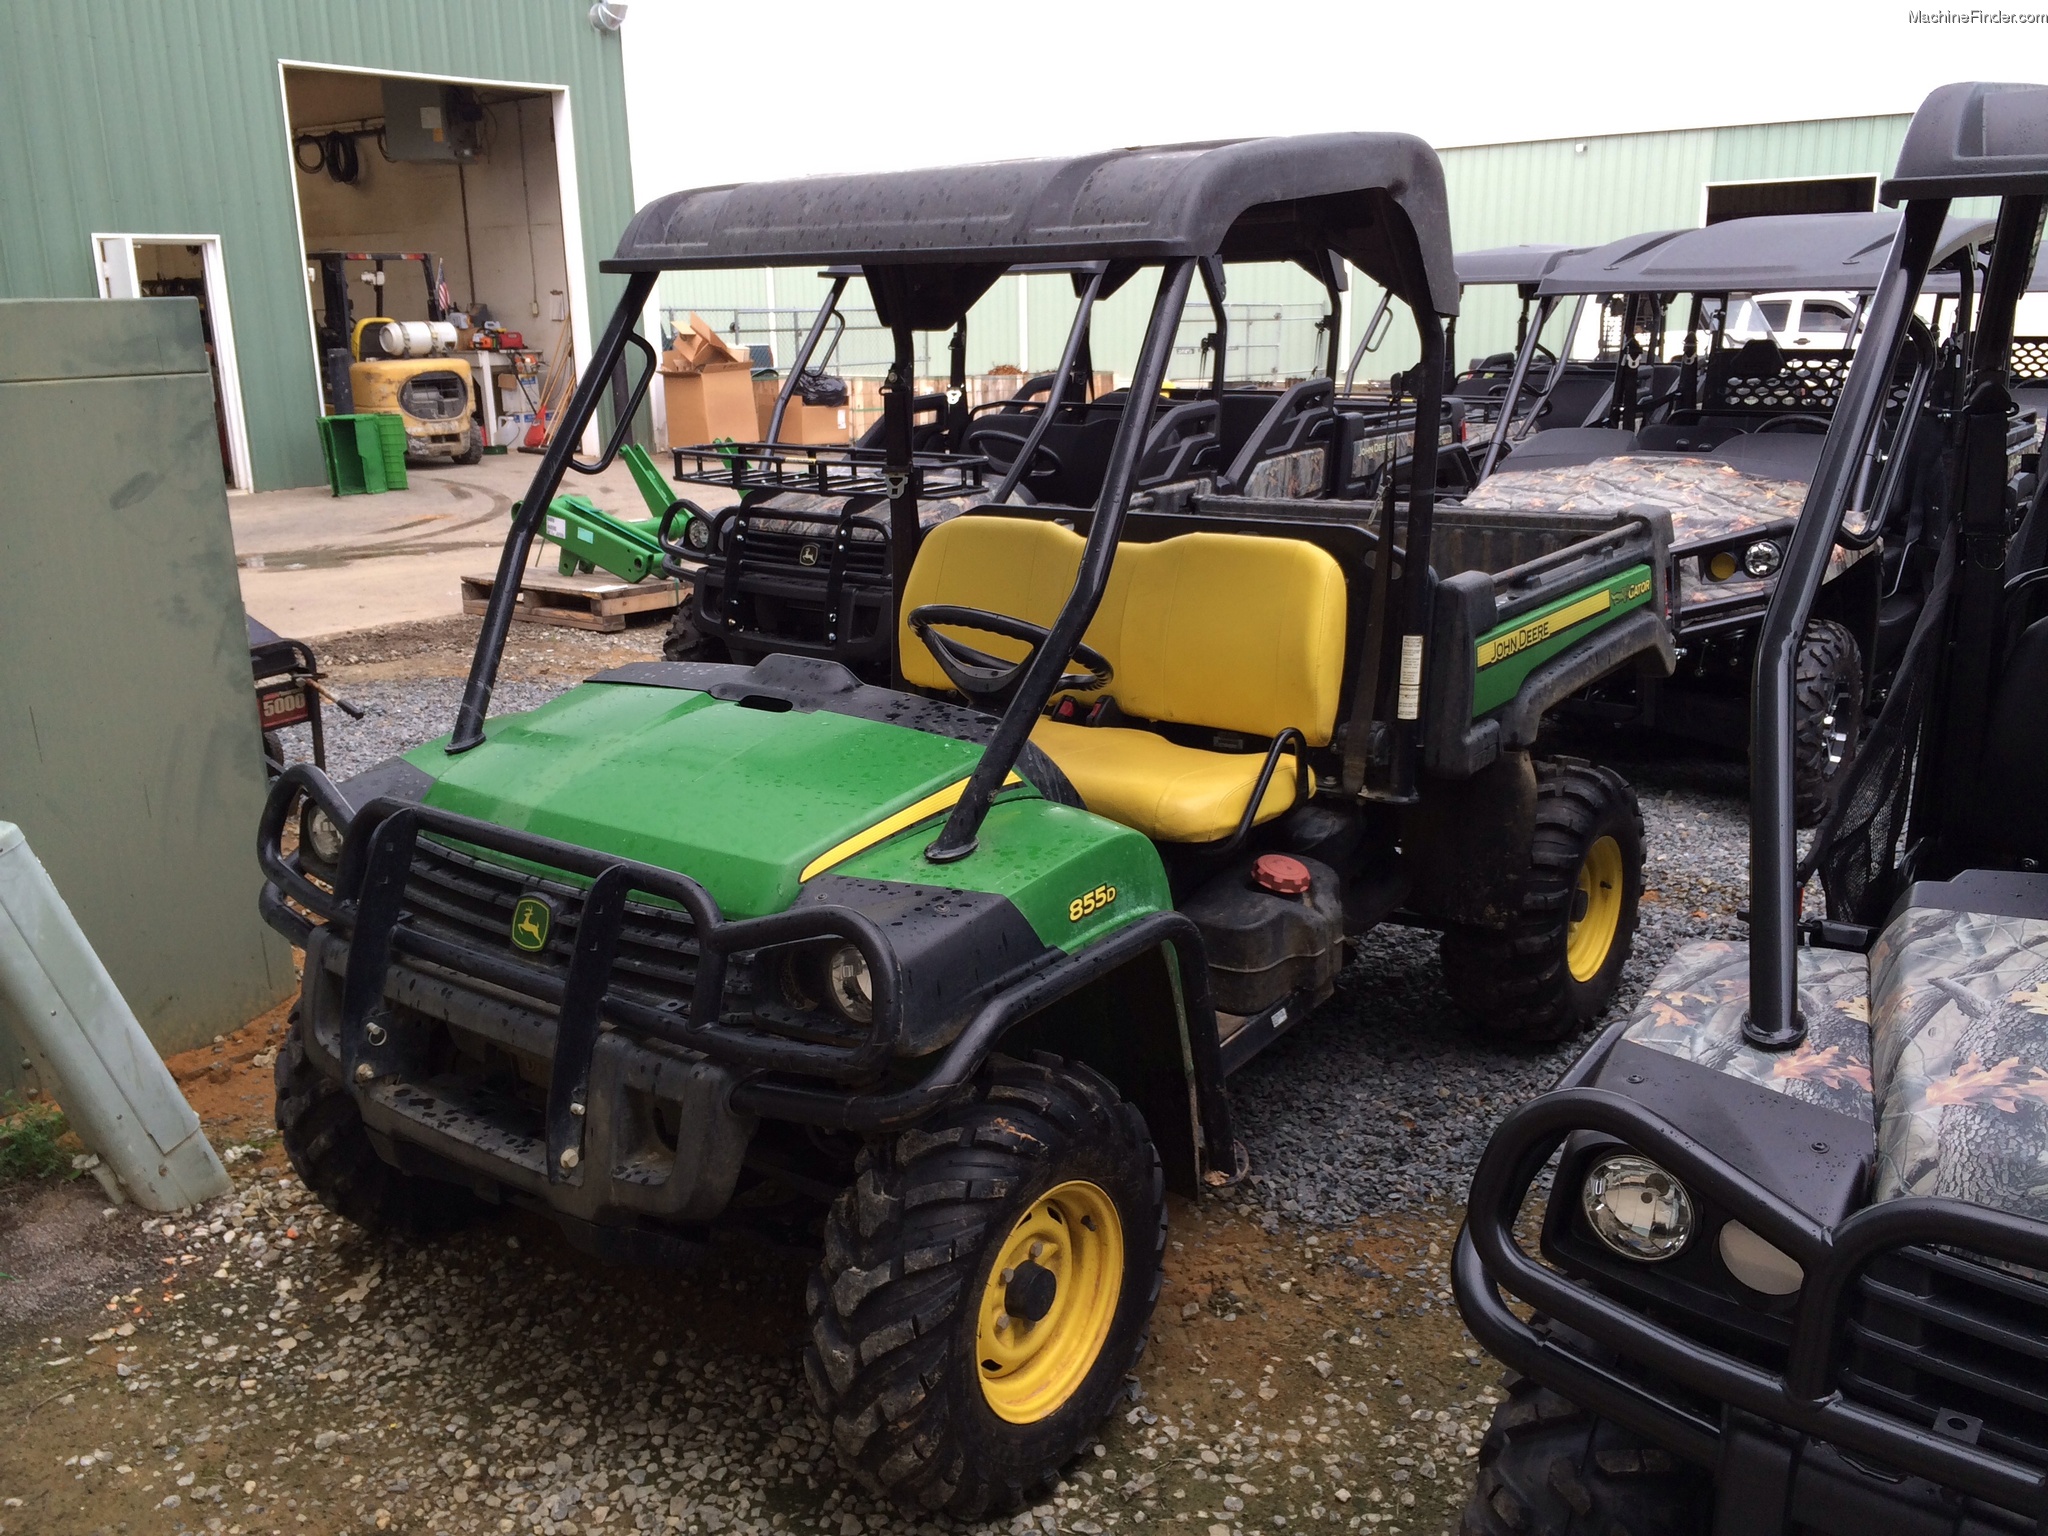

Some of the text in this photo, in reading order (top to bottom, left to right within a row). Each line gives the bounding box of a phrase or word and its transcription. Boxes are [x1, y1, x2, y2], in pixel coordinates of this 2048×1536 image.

[1628, 580, 1650, 600] GATOR
[1491, 622, 1549, 662] JOHN DEERE
[263, 692, 306, 717] 5000
[1069, 884, 1116, 922] 855D
